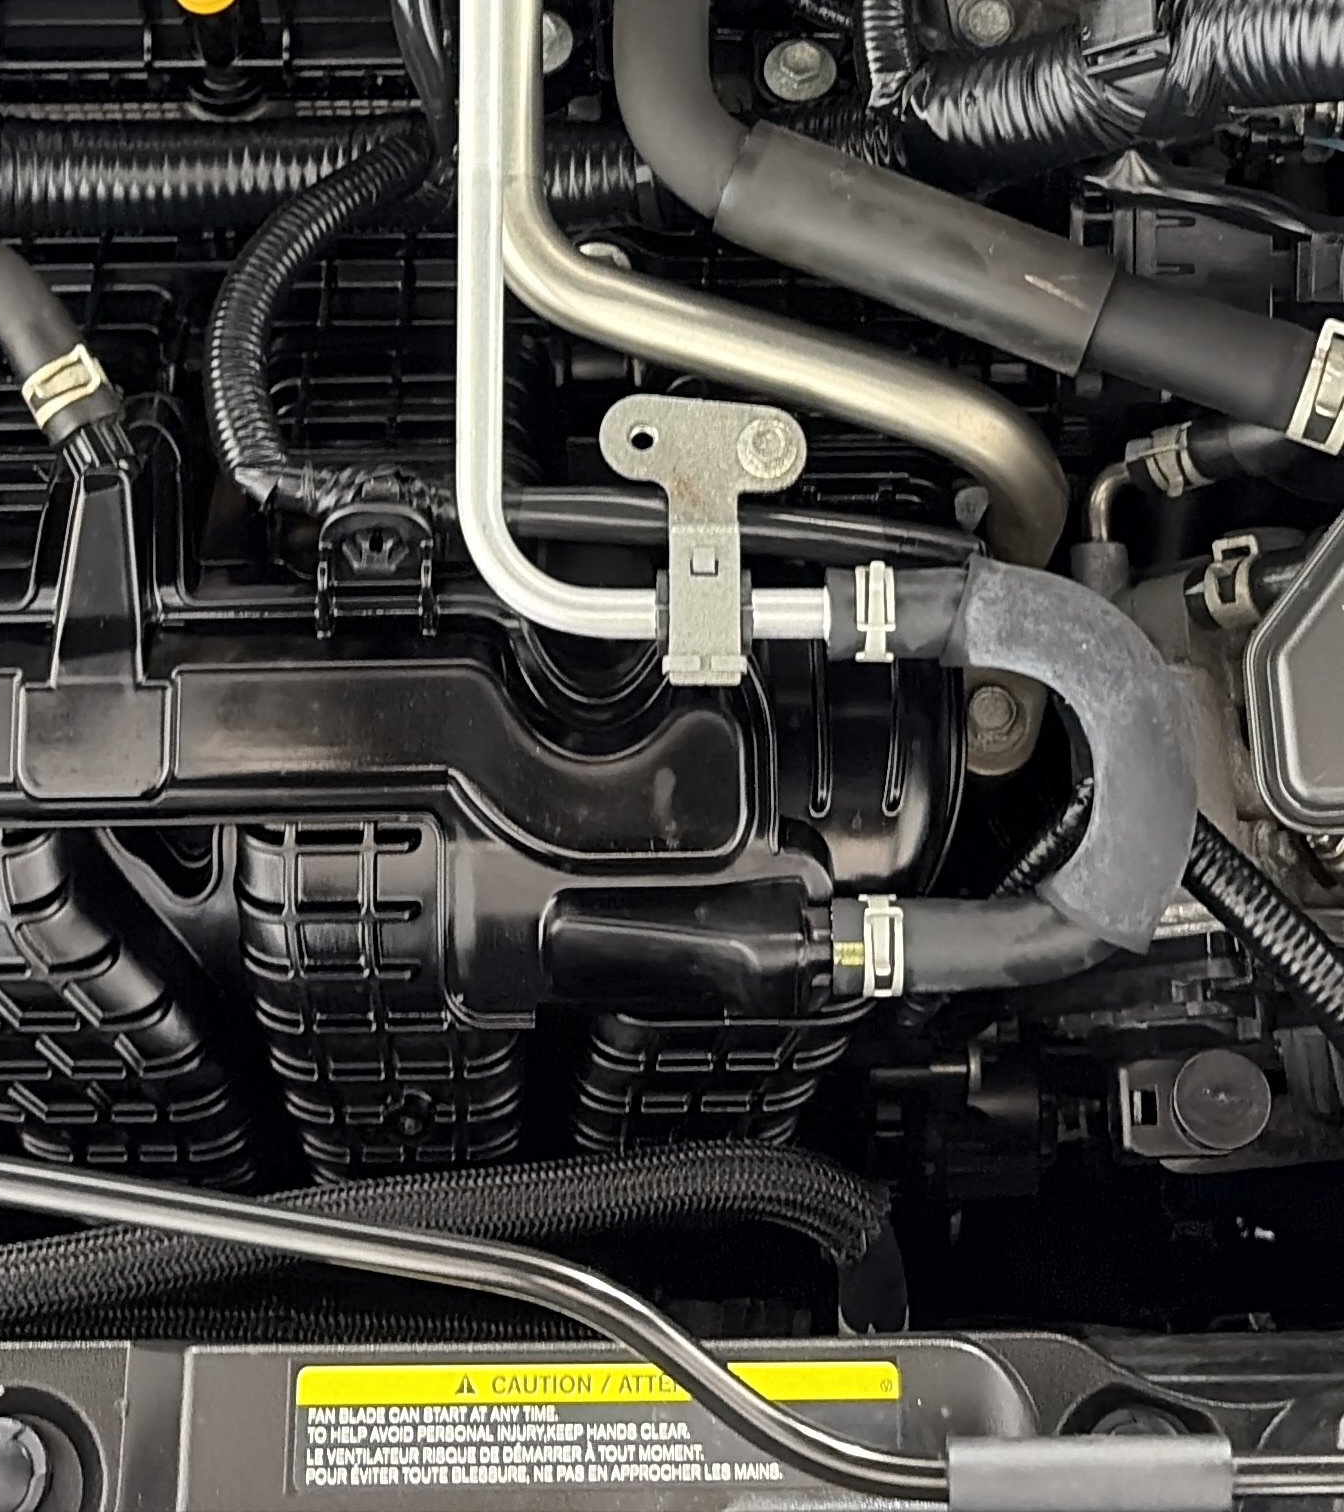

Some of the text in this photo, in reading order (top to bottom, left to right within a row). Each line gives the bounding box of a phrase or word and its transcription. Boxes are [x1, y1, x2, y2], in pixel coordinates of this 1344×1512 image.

[491, 1375, 592, 1394] CAUTION
[307, 1405, 558, 1424] FAN BLADE CAN START AT ANY TIME.
[307, 1426, 327, 1444] TO
[331, 1426, 368, 1443] HELP
[370, 1425, 414, 1443] AVOID
[417, 1425, 493, 1442] PERSONAL
[587, 1424, 637, 1440] HANDS
[640, 1423, 690, 1440] CLEAR.
[306, 1442, 704, 1466] LE VENTILATEUR RISQUE DE DÉMARRER À TOUT MOMENT.
[306, 1462, 783, 1485] POUR ÉVITER TOUTE BLESSURE, NE PAS EN APPROCHER LES MAINS.
